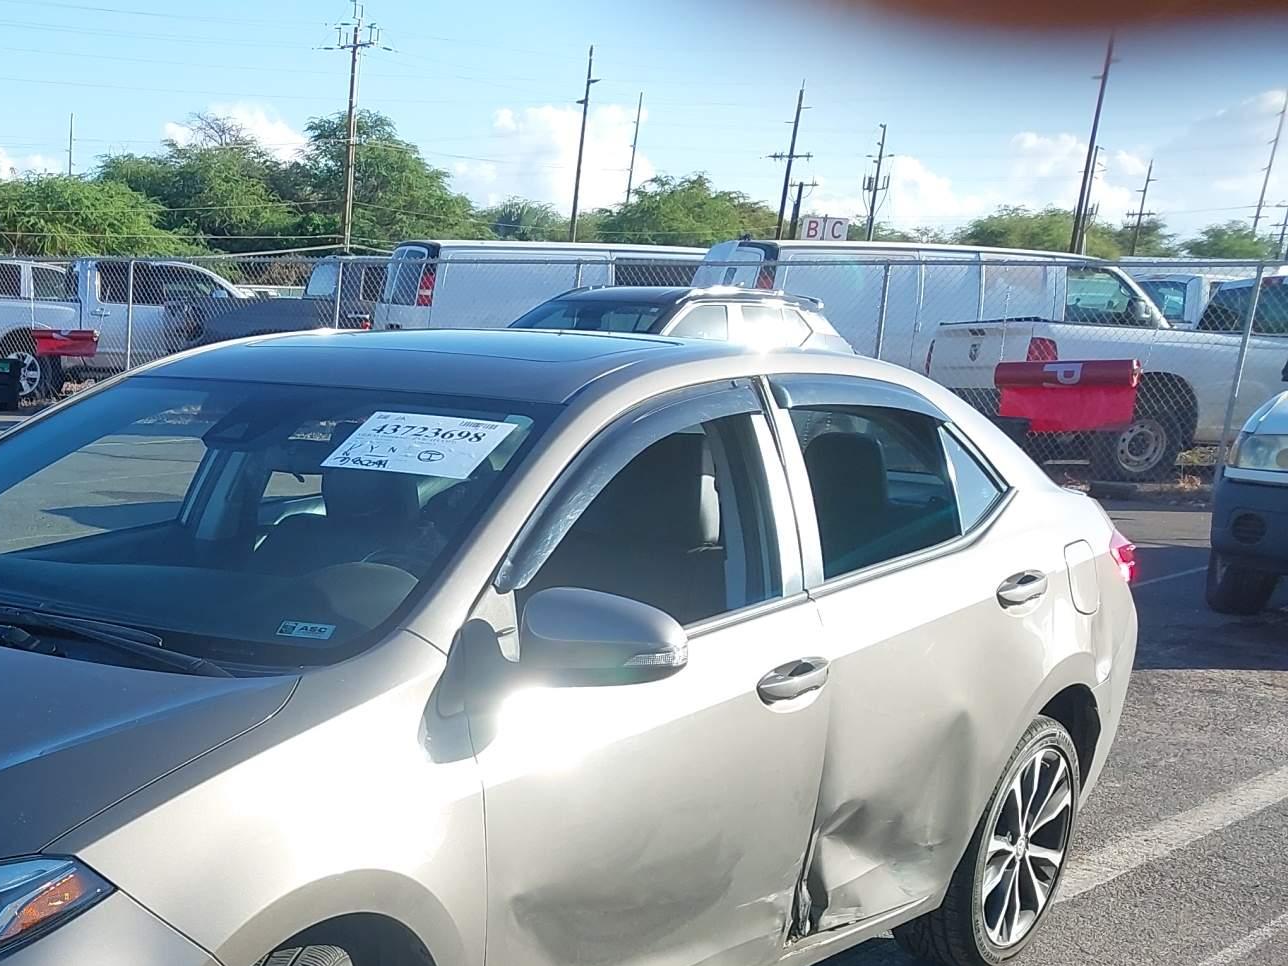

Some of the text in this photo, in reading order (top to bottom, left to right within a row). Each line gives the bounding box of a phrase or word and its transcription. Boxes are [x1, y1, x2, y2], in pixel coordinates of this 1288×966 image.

[806, 220, 844, 239] B C
[372, 423, 486, 443] 43723698
